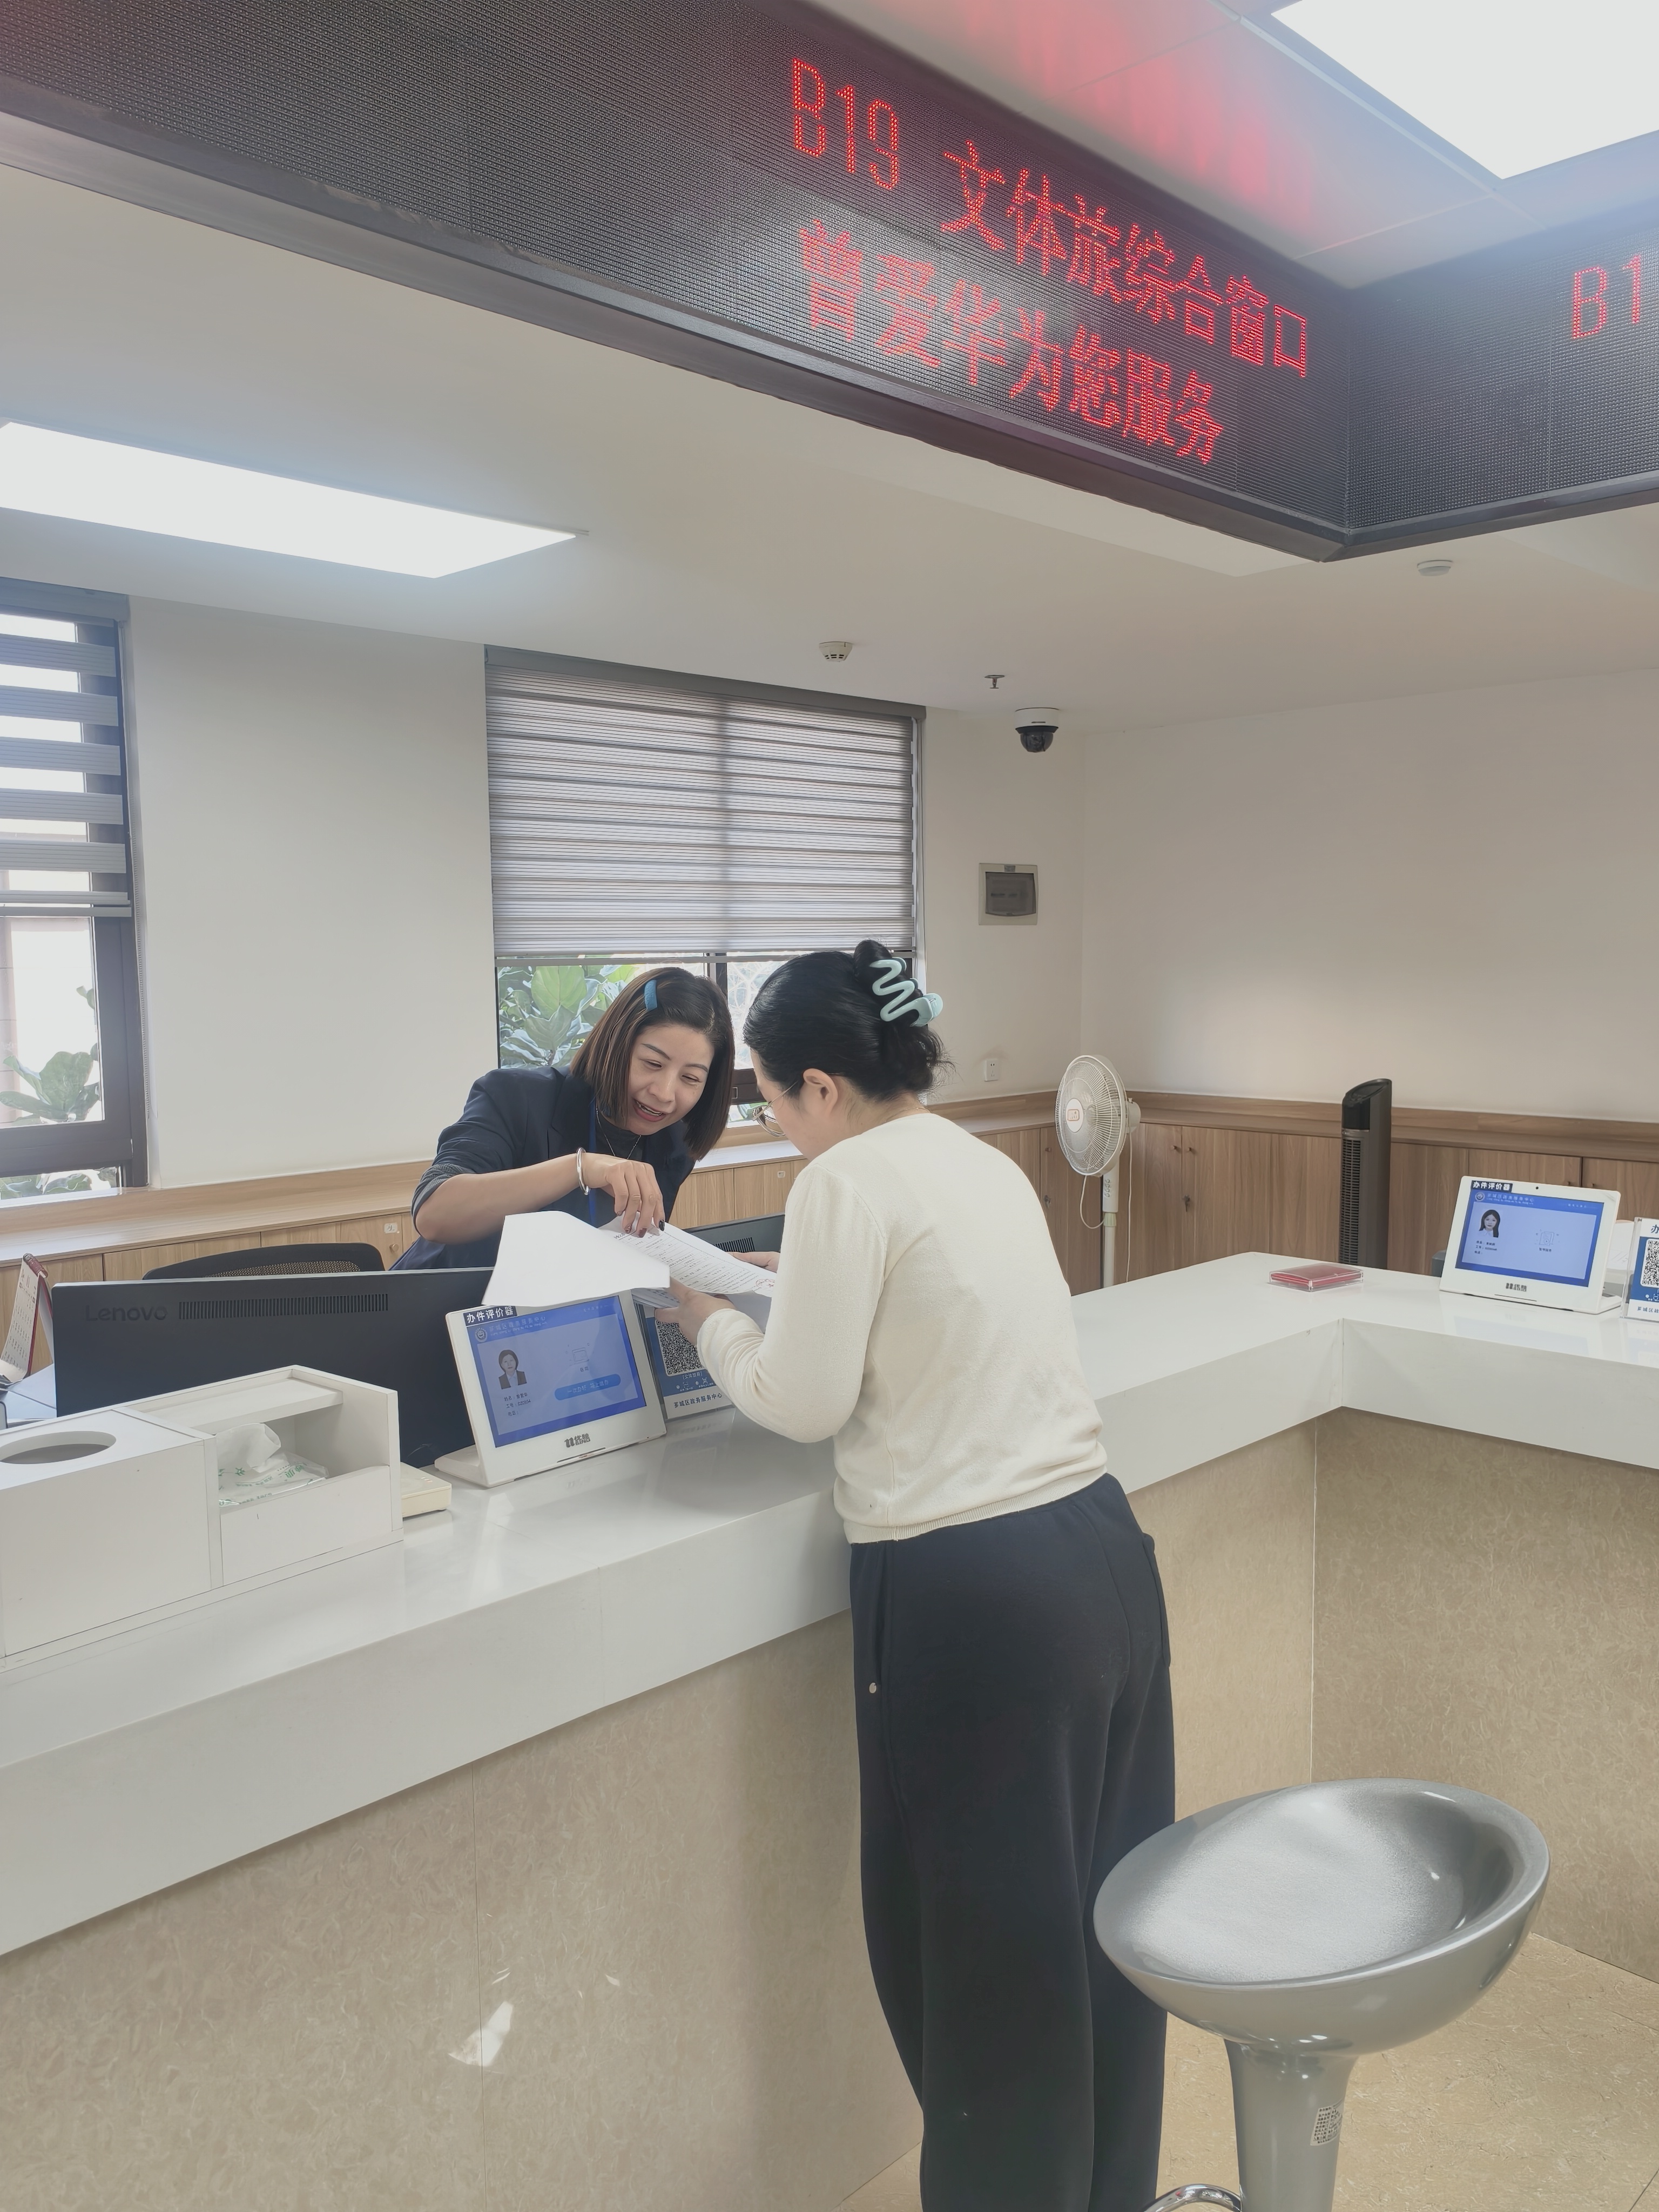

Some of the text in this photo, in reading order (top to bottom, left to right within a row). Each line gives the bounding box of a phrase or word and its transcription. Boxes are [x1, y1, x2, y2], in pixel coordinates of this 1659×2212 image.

[792, 57, 1306, 377] B19 文体旅综合窗口
[1572, 255, 1641, 339] B1
[800, 219, 1223, 464] 曾爱华为您服务
[1472, 1181, 1510, 1190] 办件评价器
[85, 1304, 168, 1321] Lenovo
[467, 1306, 514, 1324] 办件评价器
